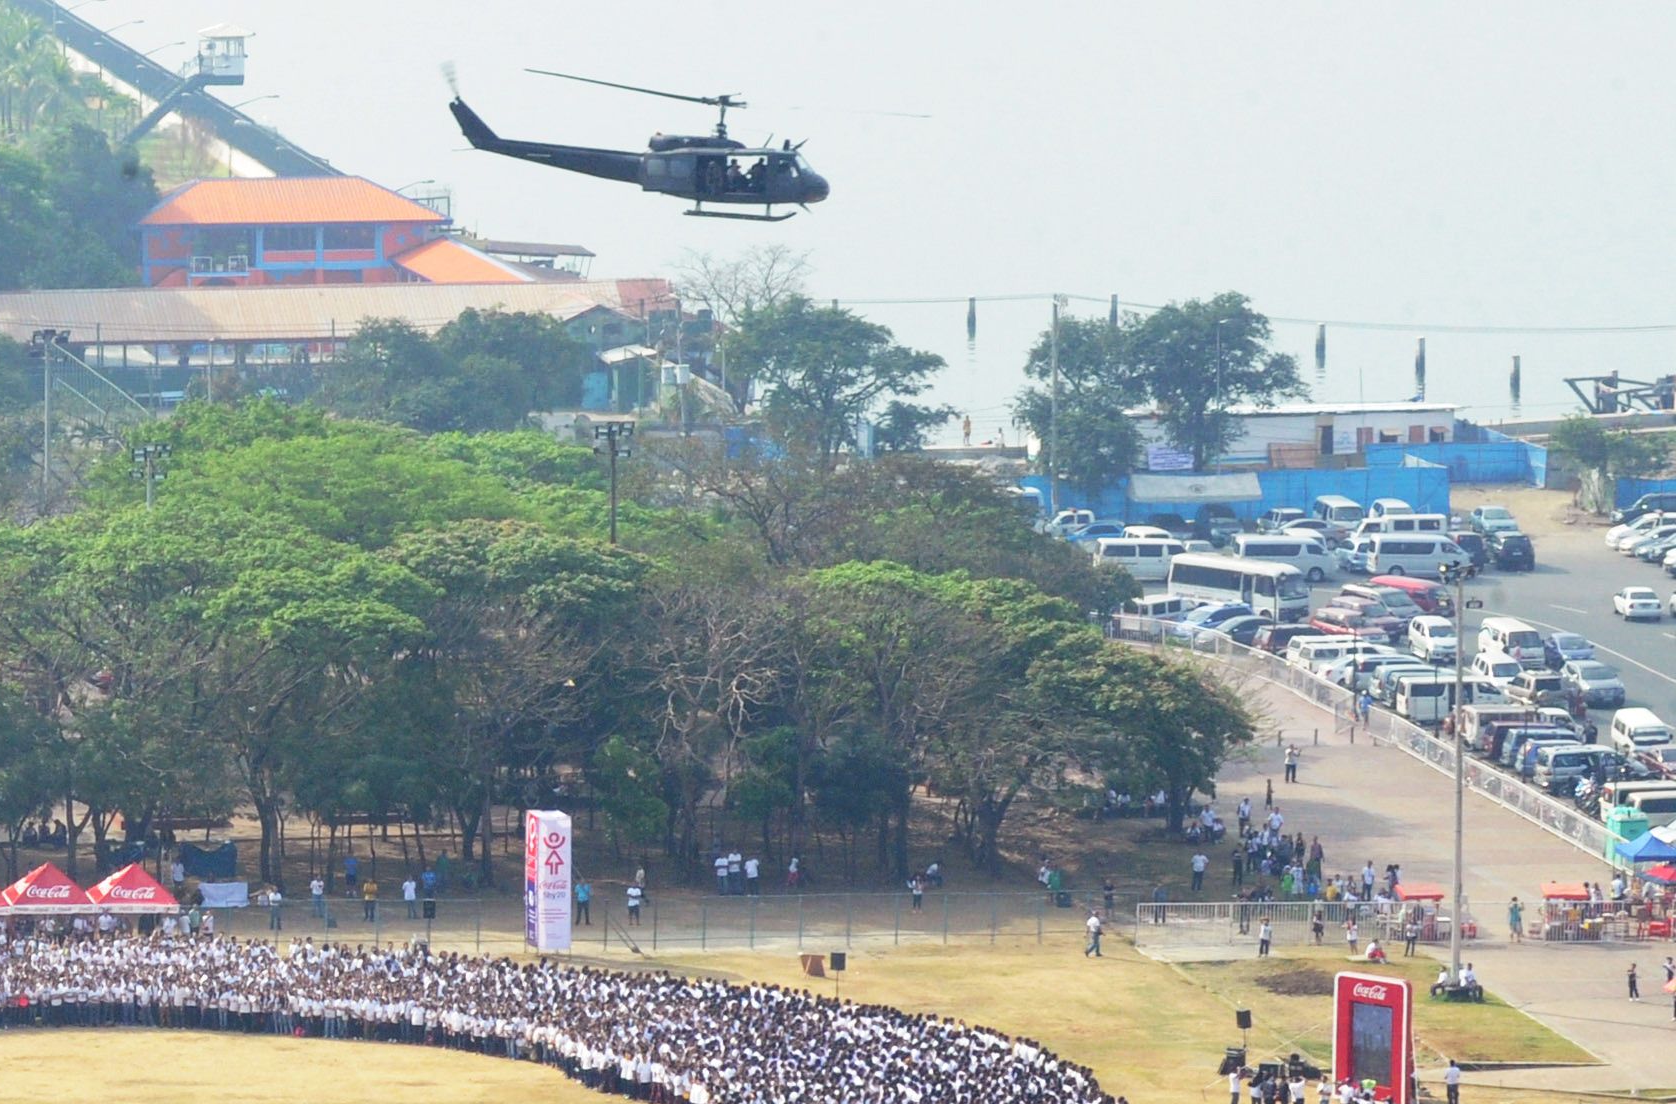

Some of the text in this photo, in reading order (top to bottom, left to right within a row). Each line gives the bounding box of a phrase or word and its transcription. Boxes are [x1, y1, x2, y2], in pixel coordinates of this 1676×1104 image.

[26, 885, 71, 899] Coca-Cola
[110, 885, 156, 900] Coca-Cola
[1353, 982, 1388, 1001] Coca-Cola
